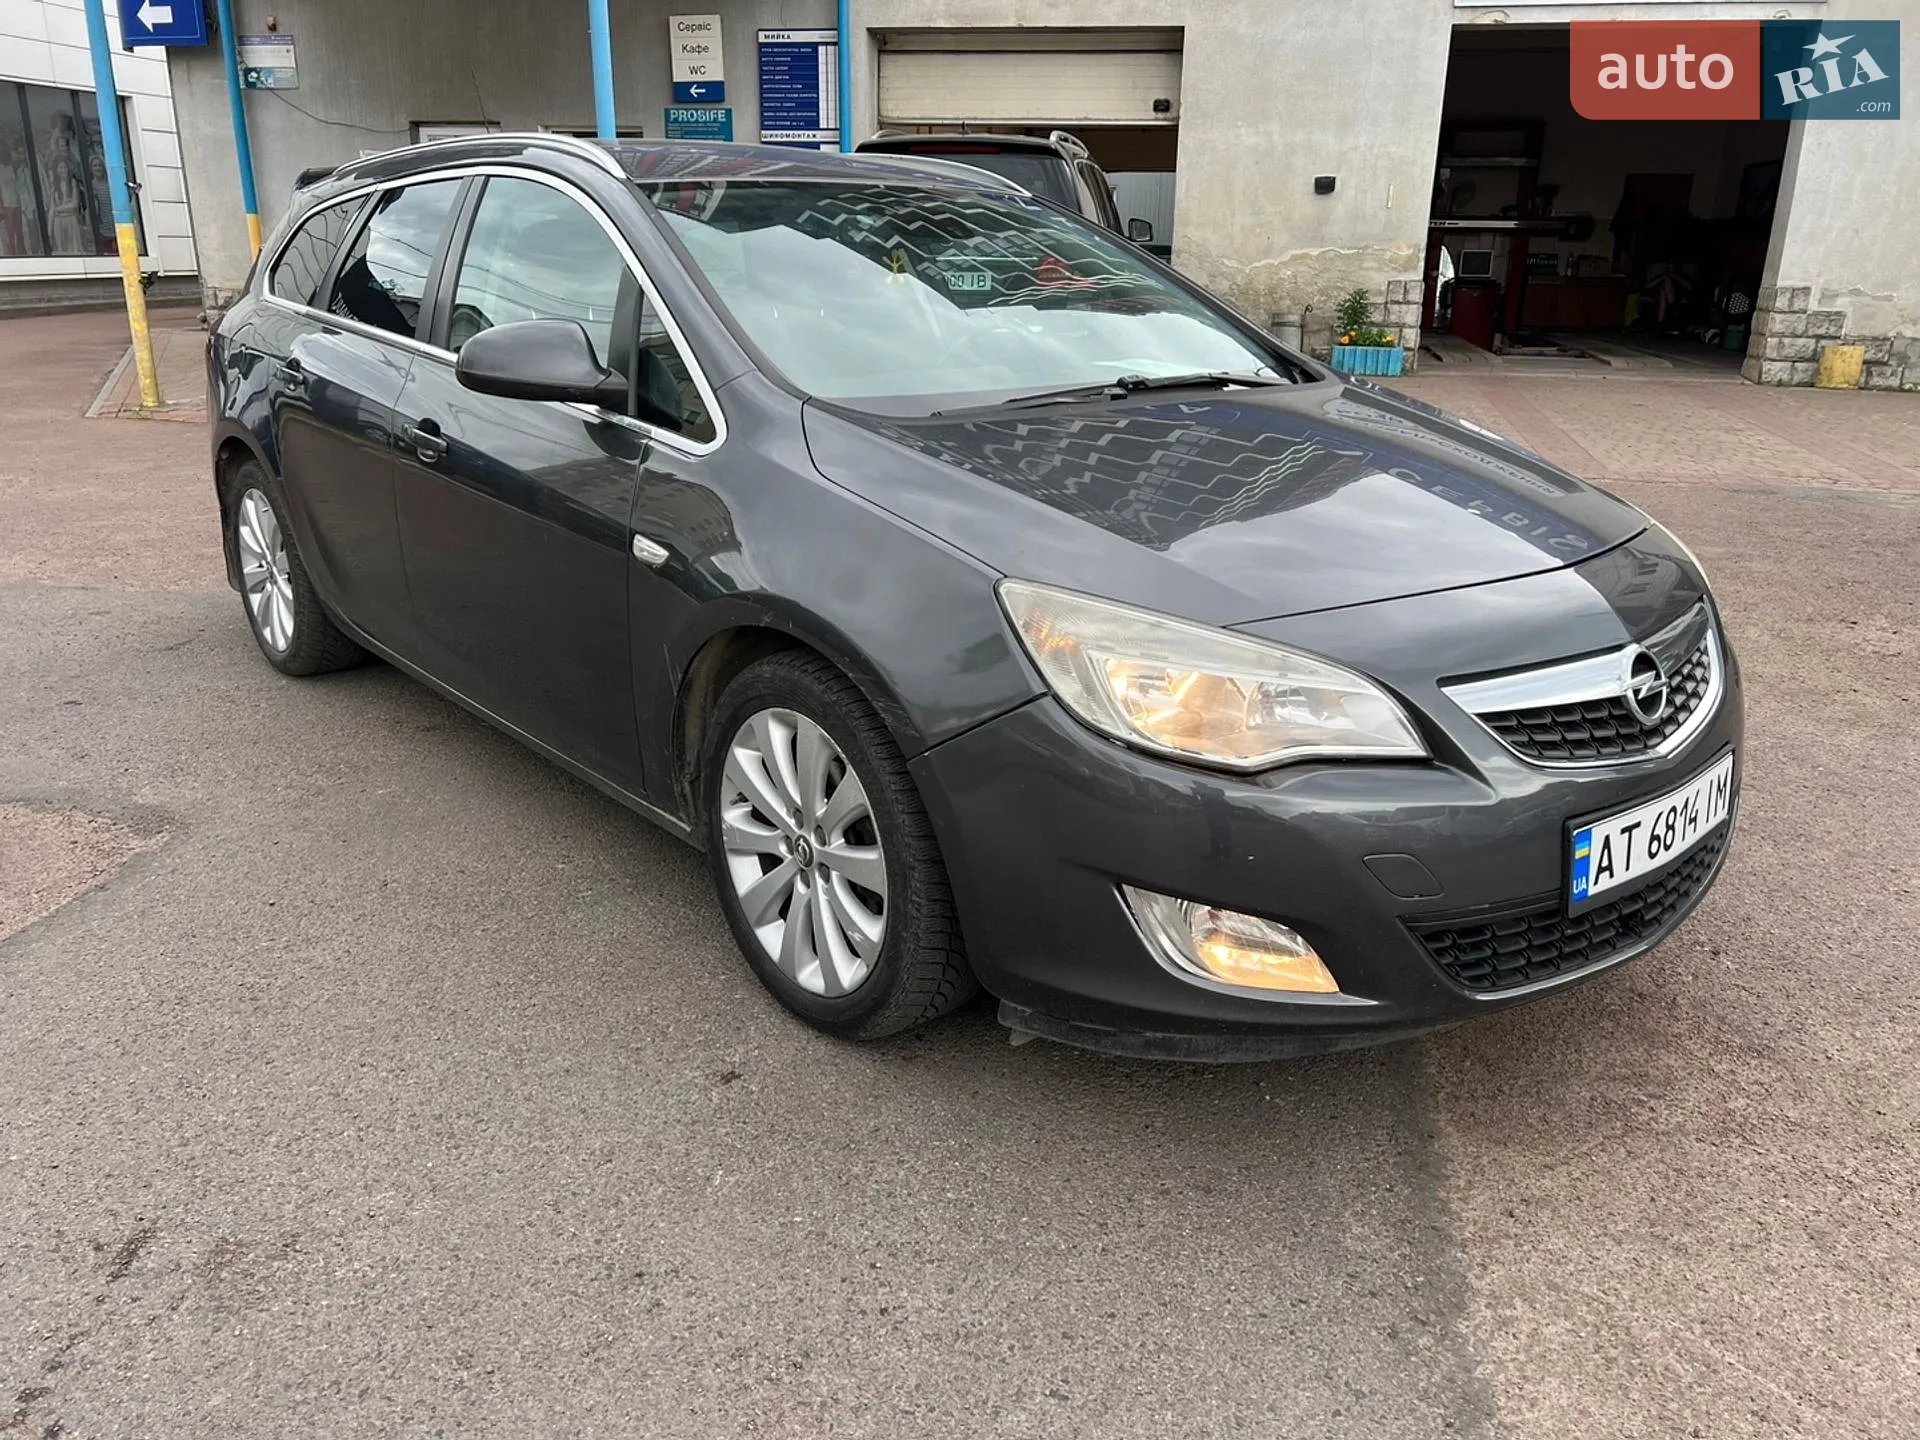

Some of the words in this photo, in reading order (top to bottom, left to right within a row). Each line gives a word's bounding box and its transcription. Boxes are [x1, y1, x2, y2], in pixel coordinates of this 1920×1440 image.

[677, 21, 712, 34] Сервіс
[763, 33, 792, 41] МИЙКА
[681, 43, 710, 55] Кафе
[688, 65, 707, 76] WC
[670, 109, 727, 122] PROSIFE
[1593, 820, 1642, 887] AT
[1647, 790, 1700, 861] 6814
[1705, 766, 1730, 824] IM
[1572, 876, 1587, 894] UA
